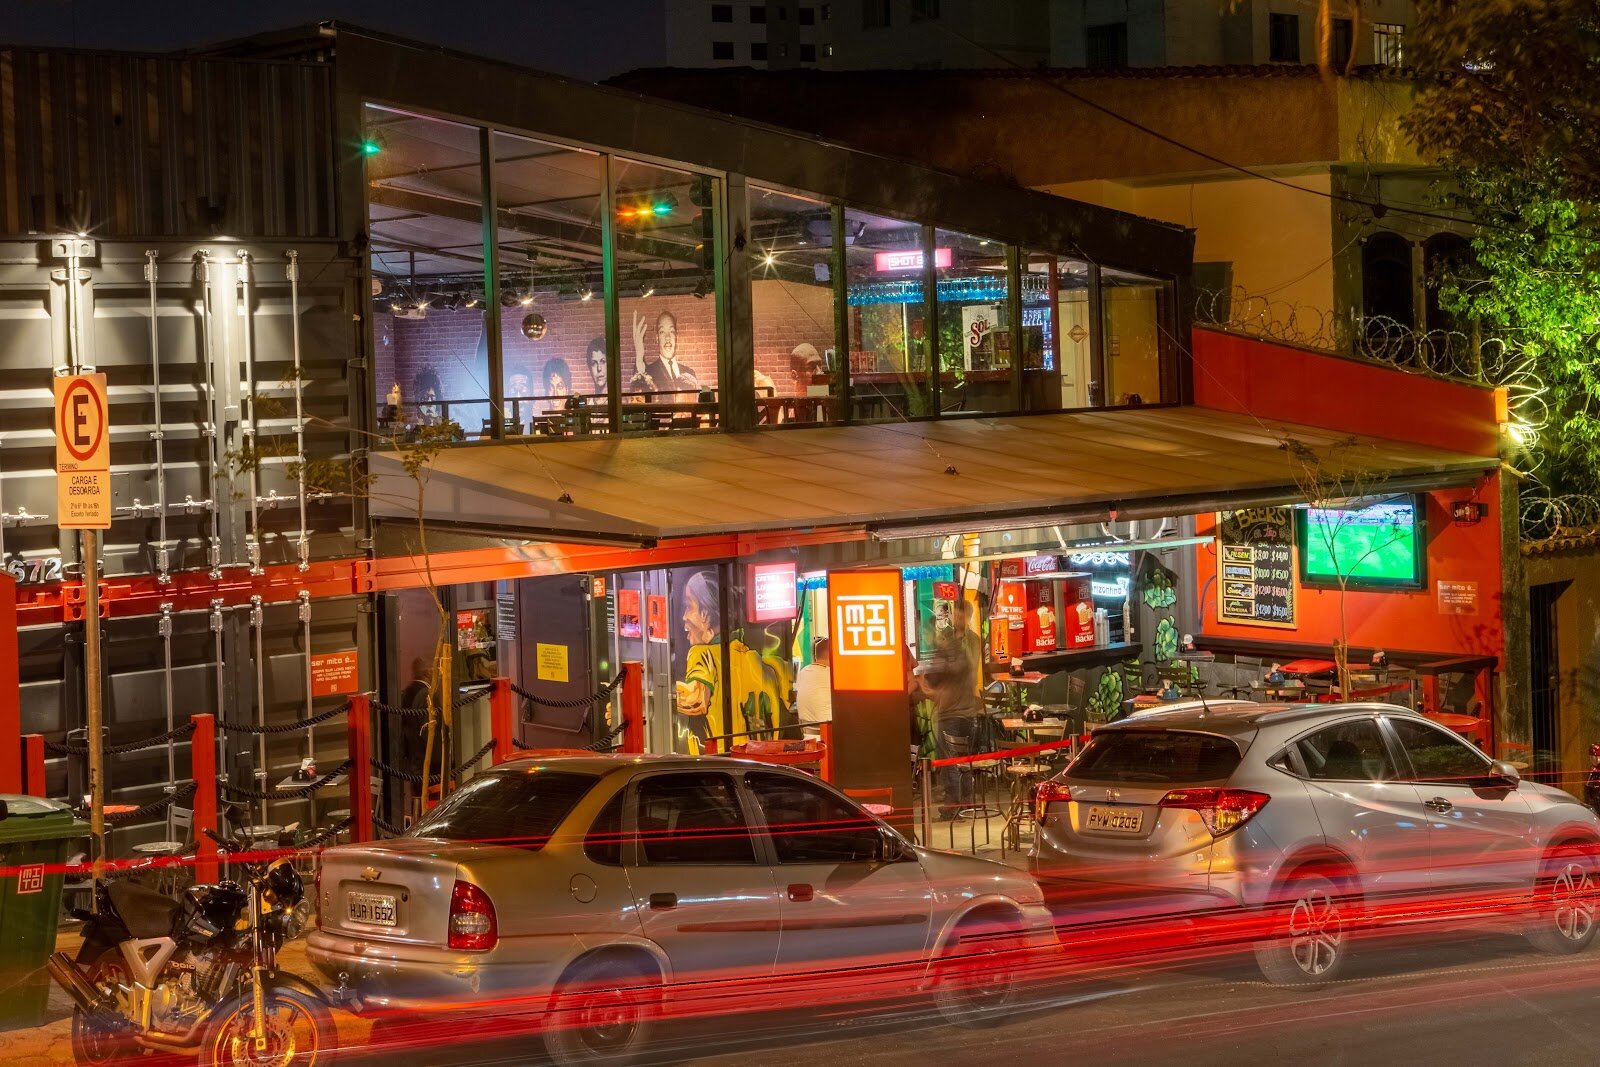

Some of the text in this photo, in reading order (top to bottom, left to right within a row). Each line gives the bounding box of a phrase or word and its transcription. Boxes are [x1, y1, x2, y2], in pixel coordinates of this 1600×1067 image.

[889, 256, 915, 267] SHOT
[73, 394, 91, 446] E
[71, 475, 98, 485] CARGA E
[69, 486, 101, 496] DESCARGA
[1235, 507, 1286, 529] BEERS
[8, 557, 62, 583] 672
